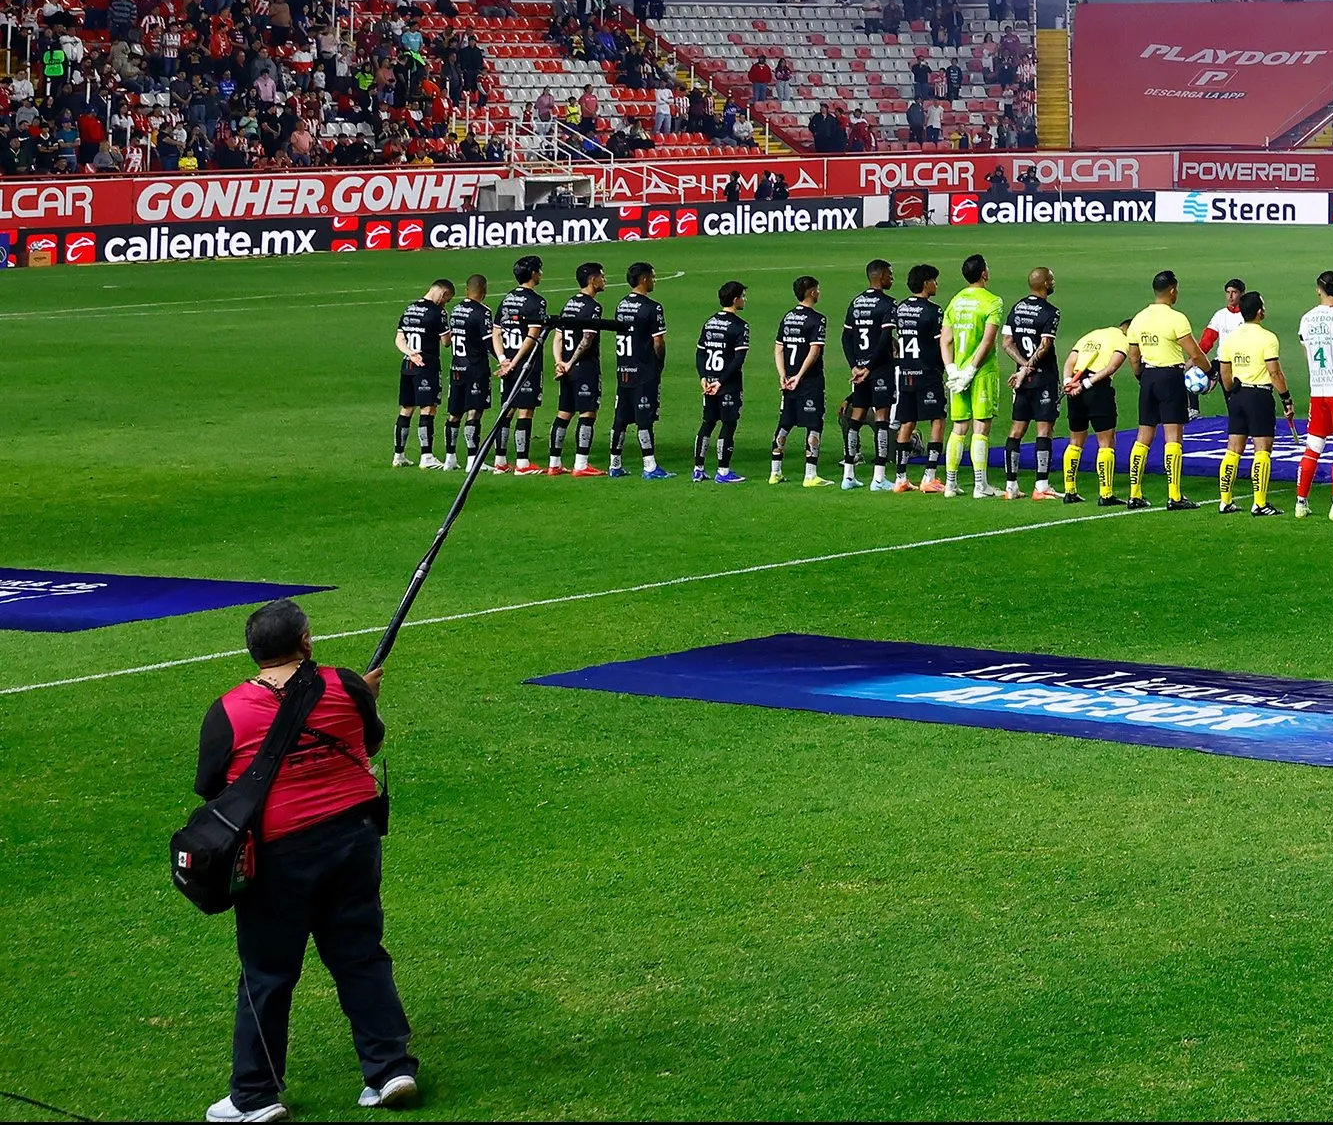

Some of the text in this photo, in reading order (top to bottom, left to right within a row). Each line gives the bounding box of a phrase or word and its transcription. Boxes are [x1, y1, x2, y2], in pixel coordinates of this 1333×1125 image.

[1140, 44, 1327, 66] PLAYDOIT
[1144, 87, 1245, 100] DESCARGA LA APP
[859, 161, 975, 194] ROLCAR
[1182, 162, 1317, 183] POWERADE
[136, 173, 482, 221] GONHER GONHE
[702, 202, 858, 236] caliente.mx
[981, 194, 1153, 225] caliente.mx
[1213, 197, 1296, 223] Steren
[430, 214, 609, 248] caliente.mx
[104, 225, 316, 264] caliente.mx
[858, 328, 870, 351] 3
[1309, 324, 1331, 336] bait
[451, 336, 467, 357] 15
[616, 335, 633, 357] 31
[898, 336, 921, 359] 14
[958, 331, 967, 353] 1
[705, 349, 725, 372] 26
[786, 343, 798, 366] 7
[1313, 347, 1327, 369] 4
